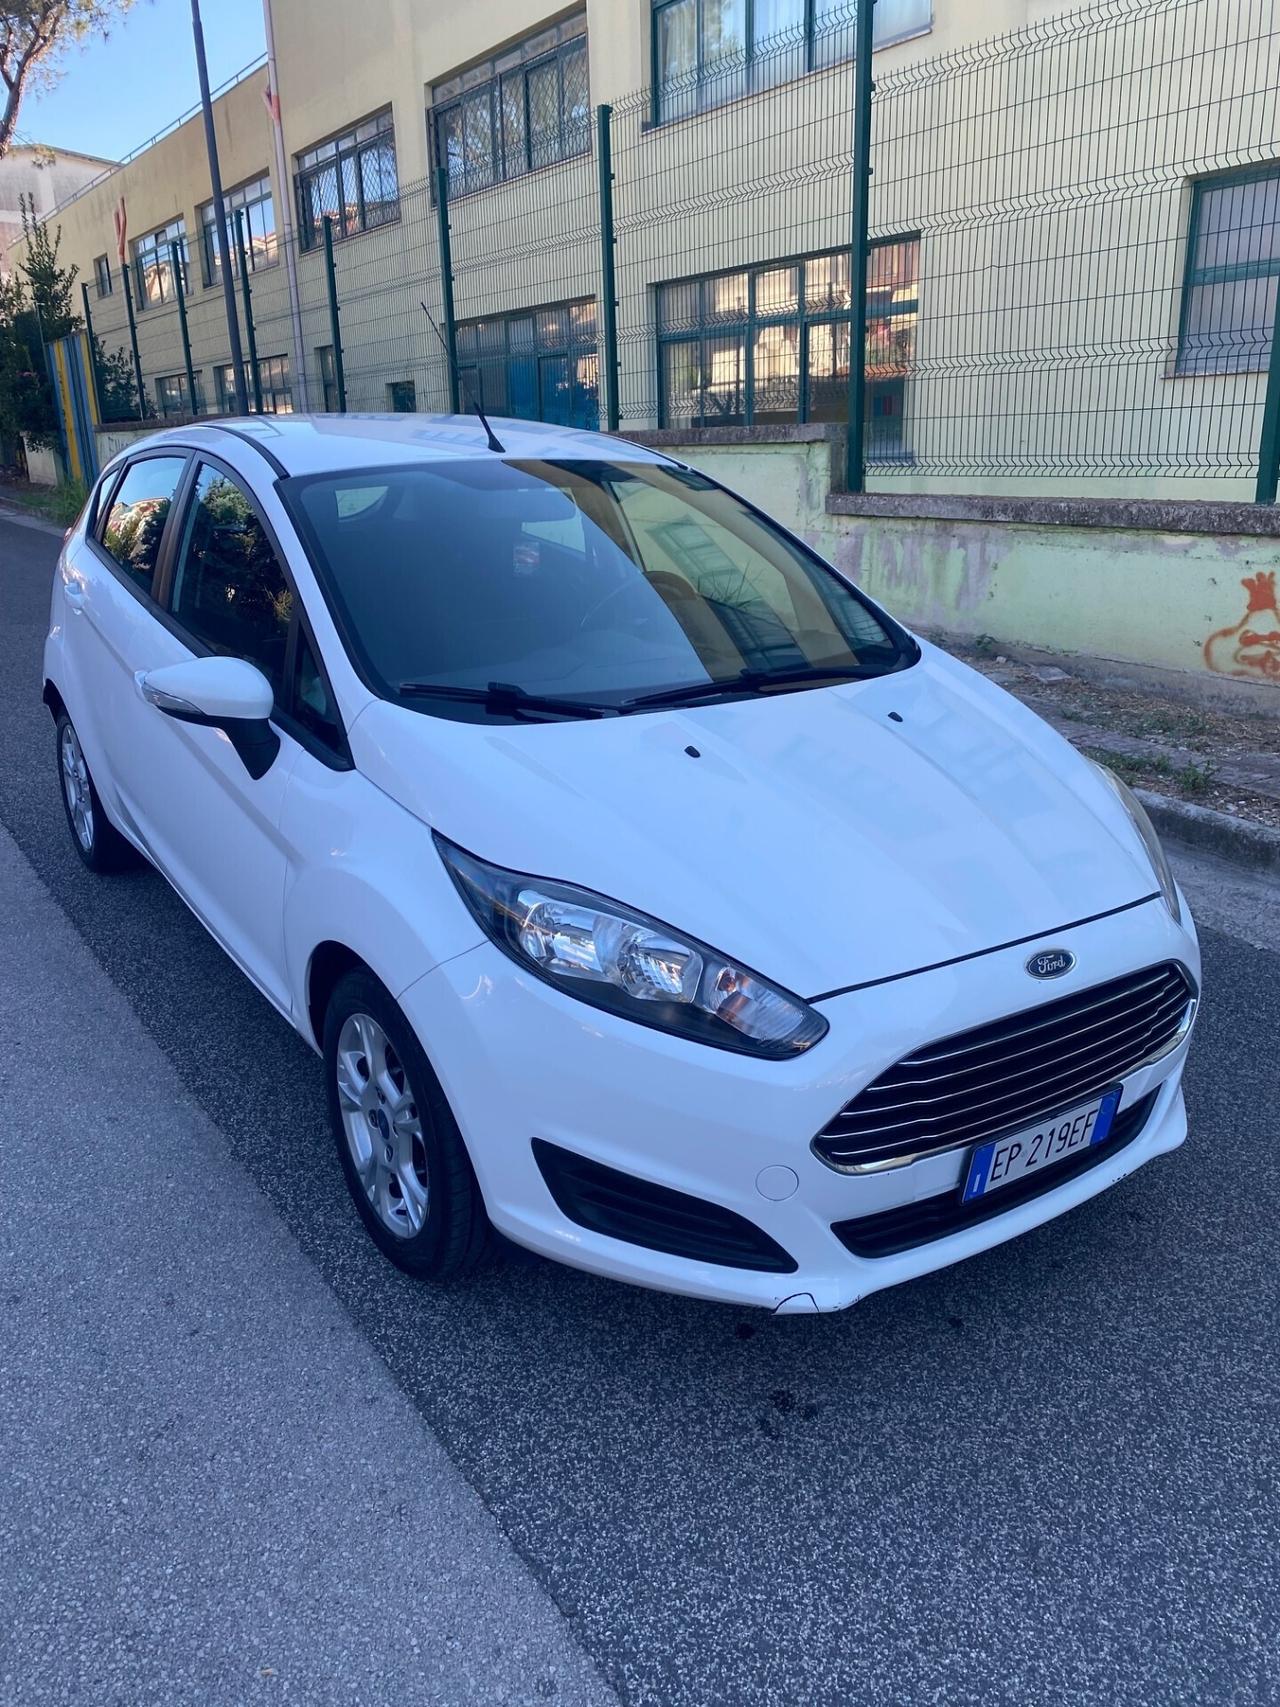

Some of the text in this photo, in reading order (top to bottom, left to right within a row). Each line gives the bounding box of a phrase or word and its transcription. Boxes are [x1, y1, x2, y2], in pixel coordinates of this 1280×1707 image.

[1037, 954, 1066, 973] Ford
[990, 1109, 1098, 1182] EP 219EF
